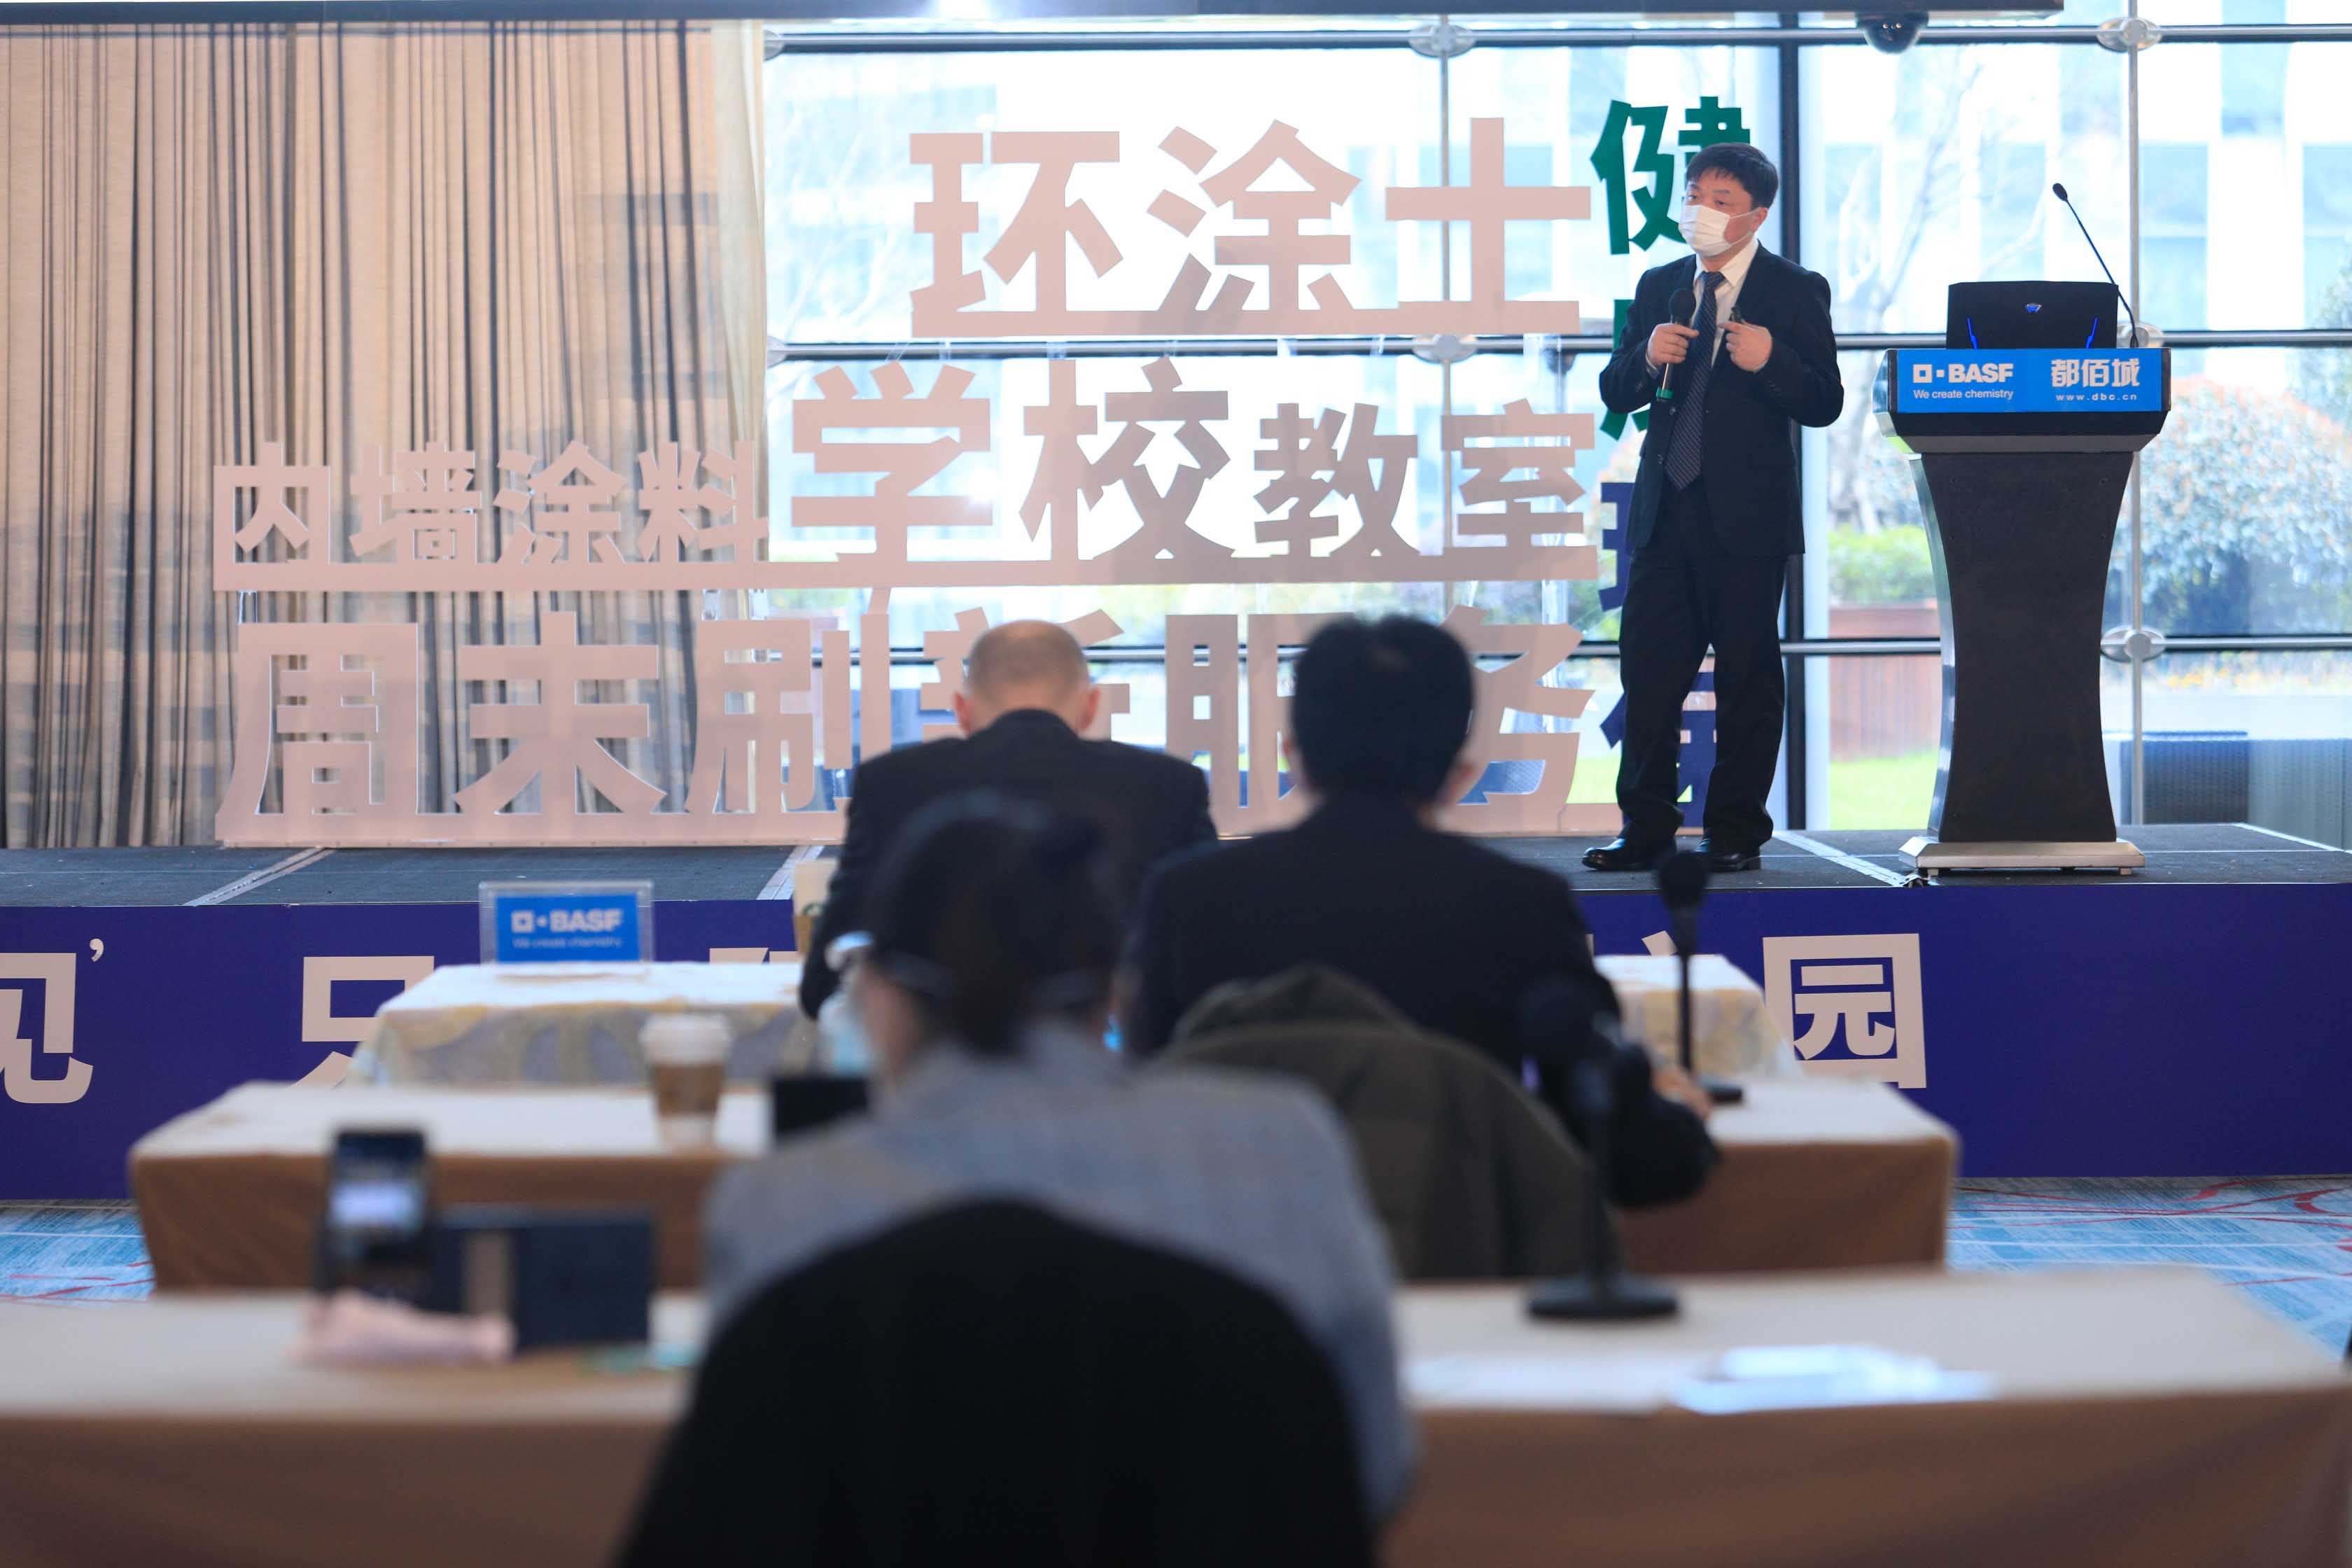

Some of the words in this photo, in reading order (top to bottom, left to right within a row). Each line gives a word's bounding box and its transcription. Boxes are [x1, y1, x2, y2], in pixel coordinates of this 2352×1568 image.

[909, 118, 1590, 336] 环涂士
[1948, 363, 2014, 384] BASF
[2051, 358, 2140, 388] 都佰城
[1913, 390, 1929, 399] We
[1932, 390, 1962, 399] create
[1965, 389, 2013, 400] chemistry
[213, 356, 1598, 591] 内墙涂料学校教室
[550, 909, 623, 933] BASF
